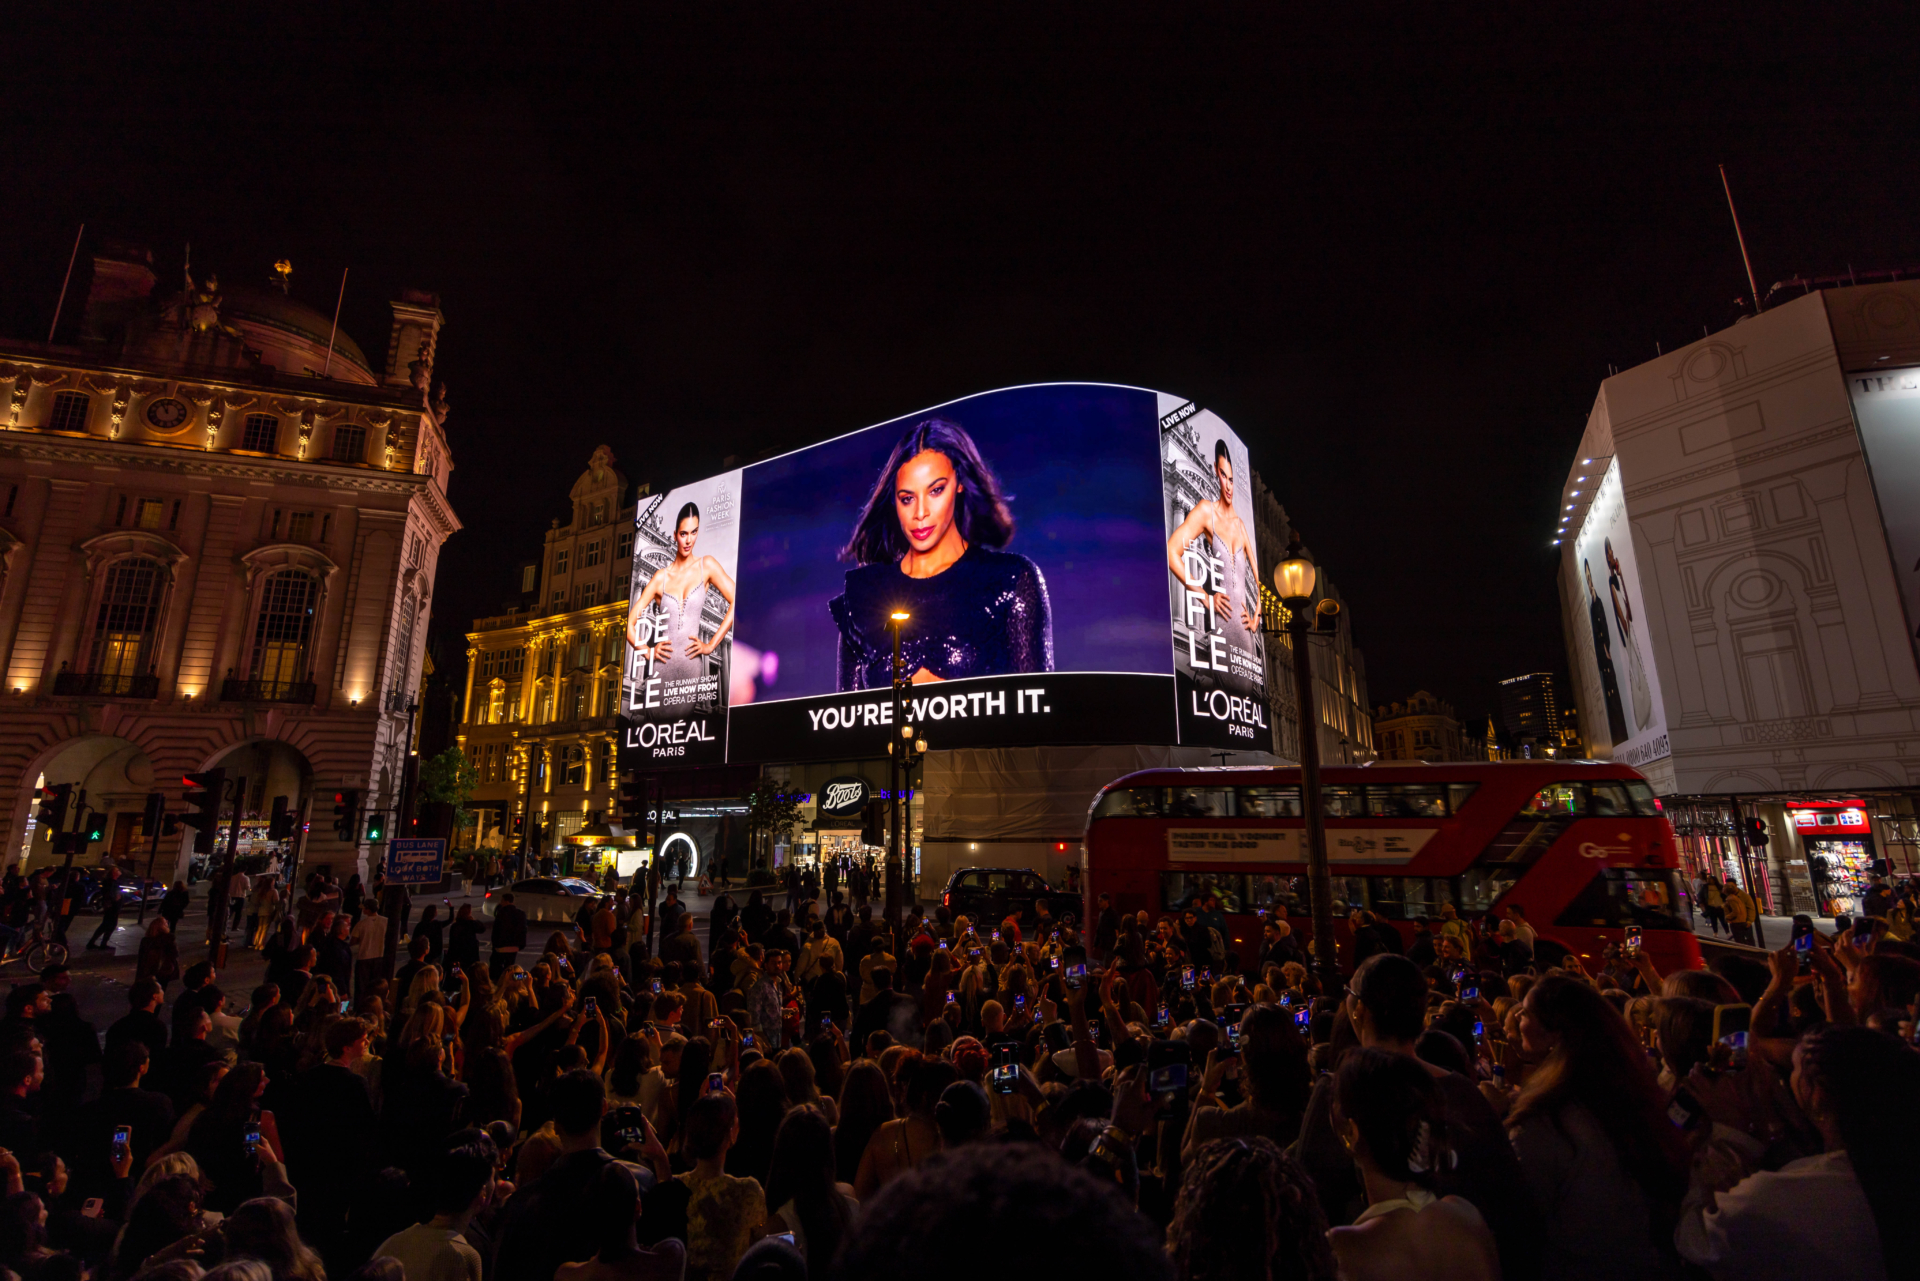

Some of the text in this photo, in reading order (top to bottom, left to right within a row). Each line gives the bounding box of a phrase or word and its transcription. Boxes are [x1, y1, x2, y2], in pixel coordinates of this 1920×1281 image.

[1161, 402, 1196, 429] LIVE NOW
[636, 493, 663, 529] LIVE NOW
[706, 500, 735, 515] FASHION
[712, 492, 731, 505] PARIS
[710, 509, 730, 521] WEEK
[1183, 550, 1227, 594] DÉ
[1186, 590, 1216, 630] FI
[634, 606, 671, 647] DÉ
[631, 647, 655, 679] FI
[1188, 627, 1229, 673] LÉ
[1229, 644, 1239, 655] THE
[1230, 653, 1263, 675] LIVE NOW FROM
[629, 671, 662, 711] LÉ
[663, 681, 718, 697] LIVE NOW FROM
[664, 674, 718, 688] THE RUNWAY SHOW
[686, 693, 697, 703] DE
[697, 691, 717, 701] PARIS
[808, 688, 1051, 731] YOU'RE WORTH IT.
[1192, 689, 1268, 729] L'ORÉAL
[626, 719, 716, 748] L'ORÉAL
[822, 782, 862, 810] Boots
[396, 841, 415, 849] BUS
[390, 864, 414, 874] LOOK
[402, 874, 426, 882] WAYS
